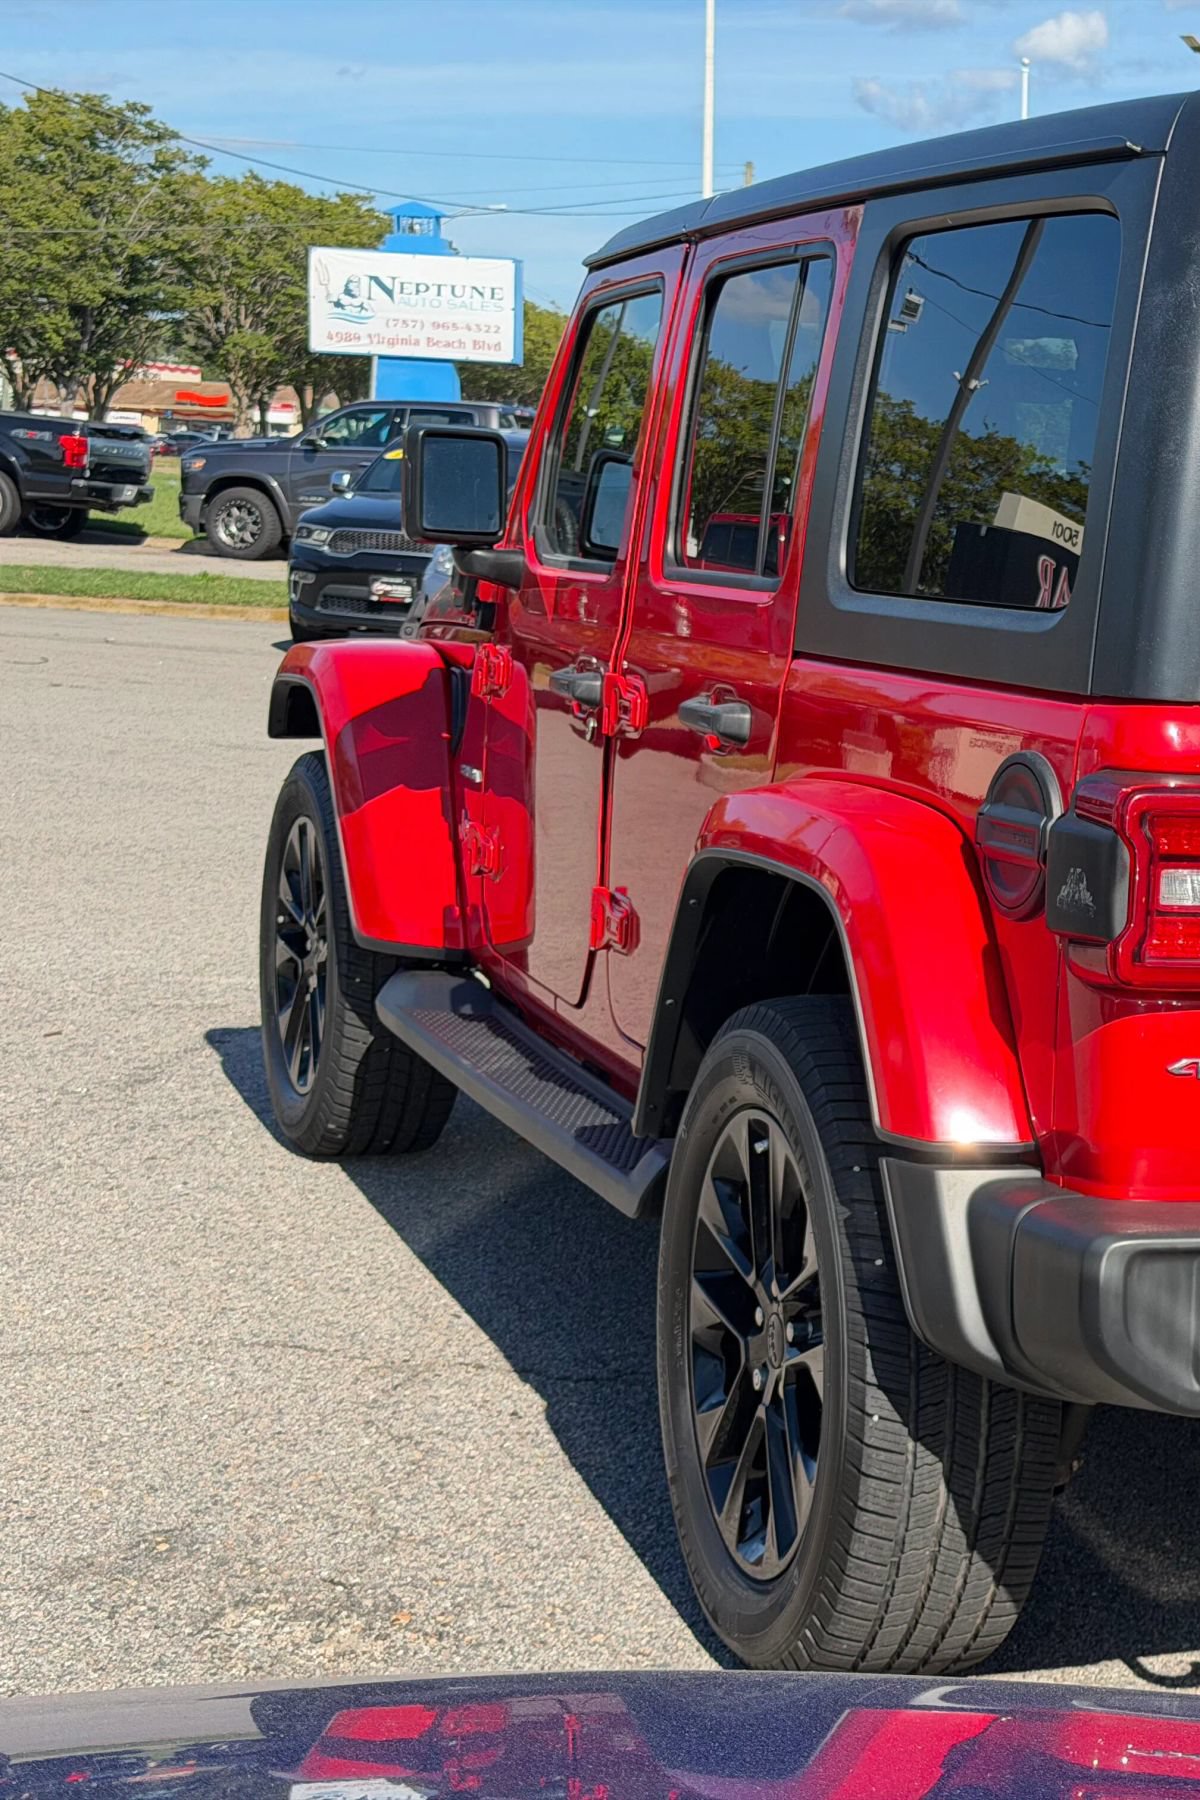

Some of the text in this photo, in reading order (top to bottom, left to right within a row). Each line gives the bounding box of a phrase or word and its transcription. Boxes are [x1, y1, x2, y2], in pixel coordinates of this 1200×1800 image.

[366, 274, 504, 303] NEPTUNE
[398, 298, 504, 312] AUTO SALES
[385, 318, 502, 334] (757) 965-4322
[368, 332, 421, 349] Virginia
[426, 336, 466, 351] Beach
[472, 339, 502, 351] Blvd
